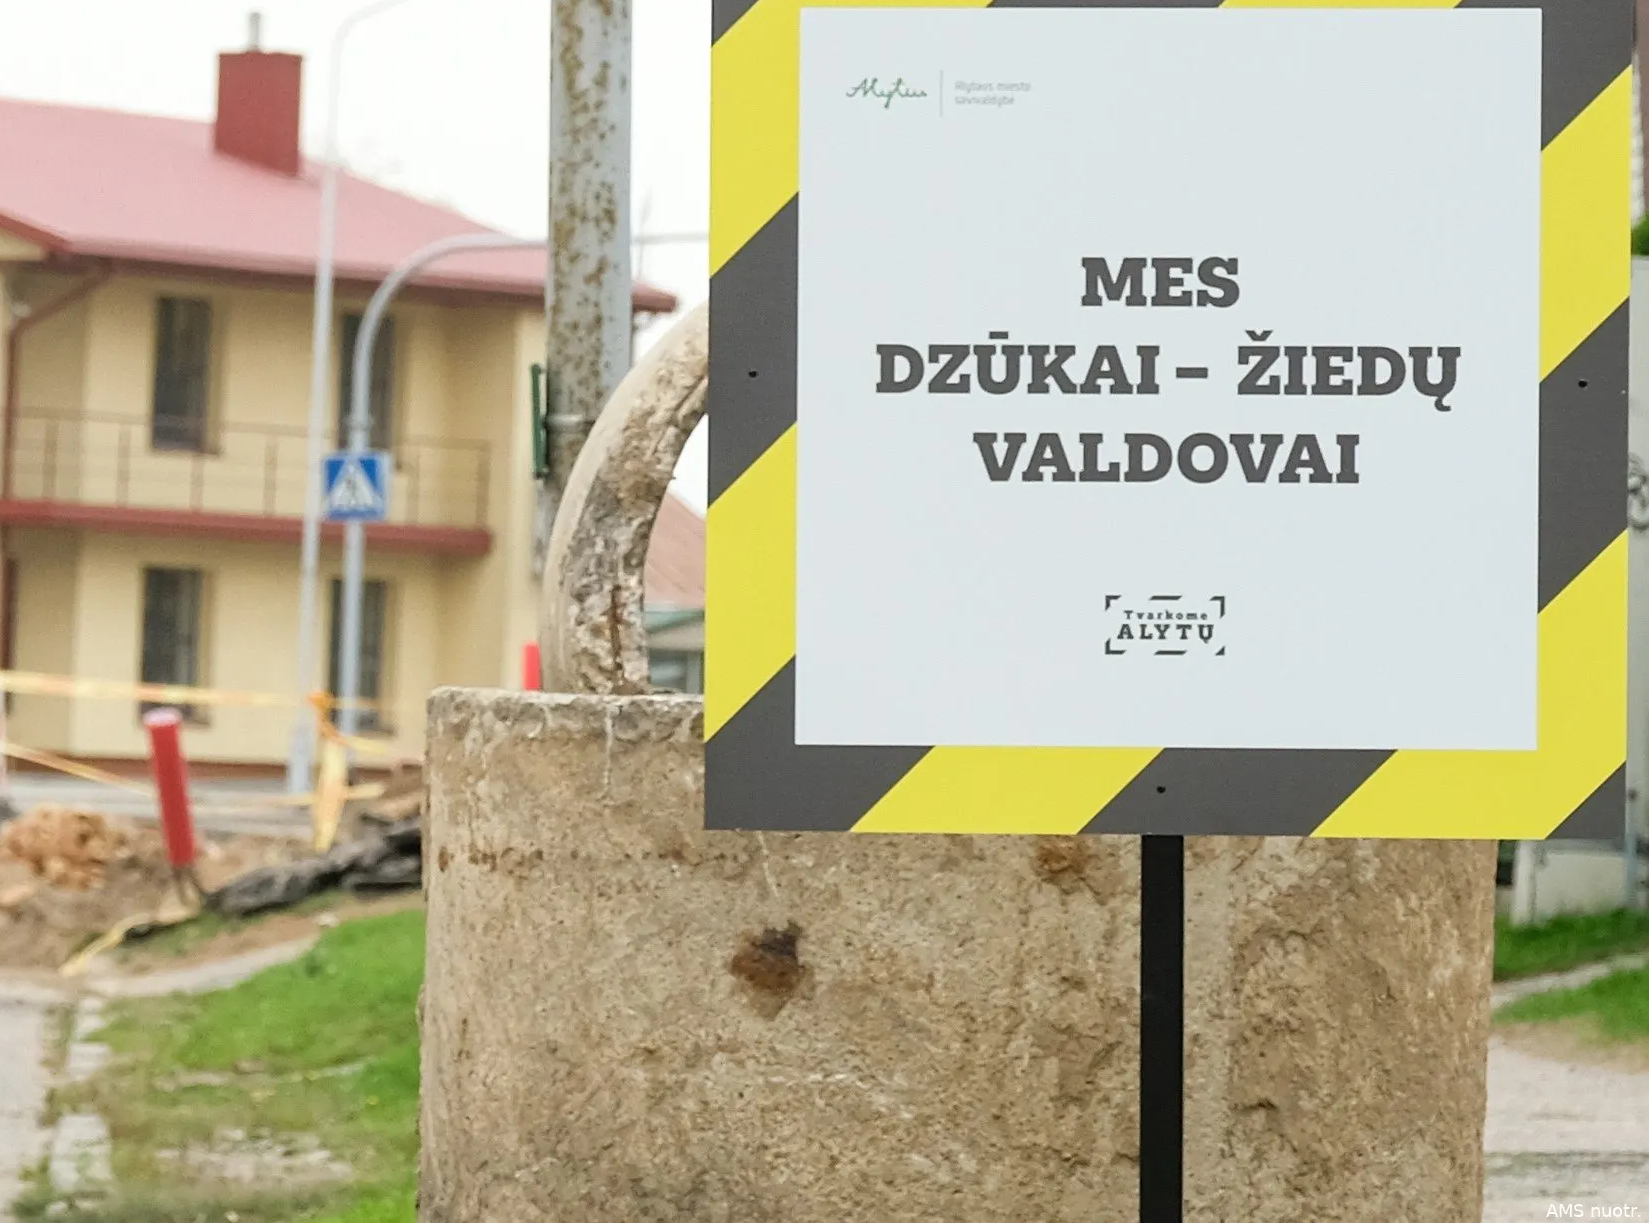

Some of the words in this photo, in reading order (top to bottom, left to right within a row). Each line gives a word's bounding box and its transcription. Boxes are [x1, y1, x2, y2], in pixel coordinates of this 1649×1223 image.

[1081, 256, 1240, 308] MES
[875, 330, 1161, 395] DZŪKAI
[1237, 329, 1462, 412] ŽIEDŲ
[972, 431, 1360, 484] VALDOVAI
[1123, 609, 1208, 620] Tvarkome
